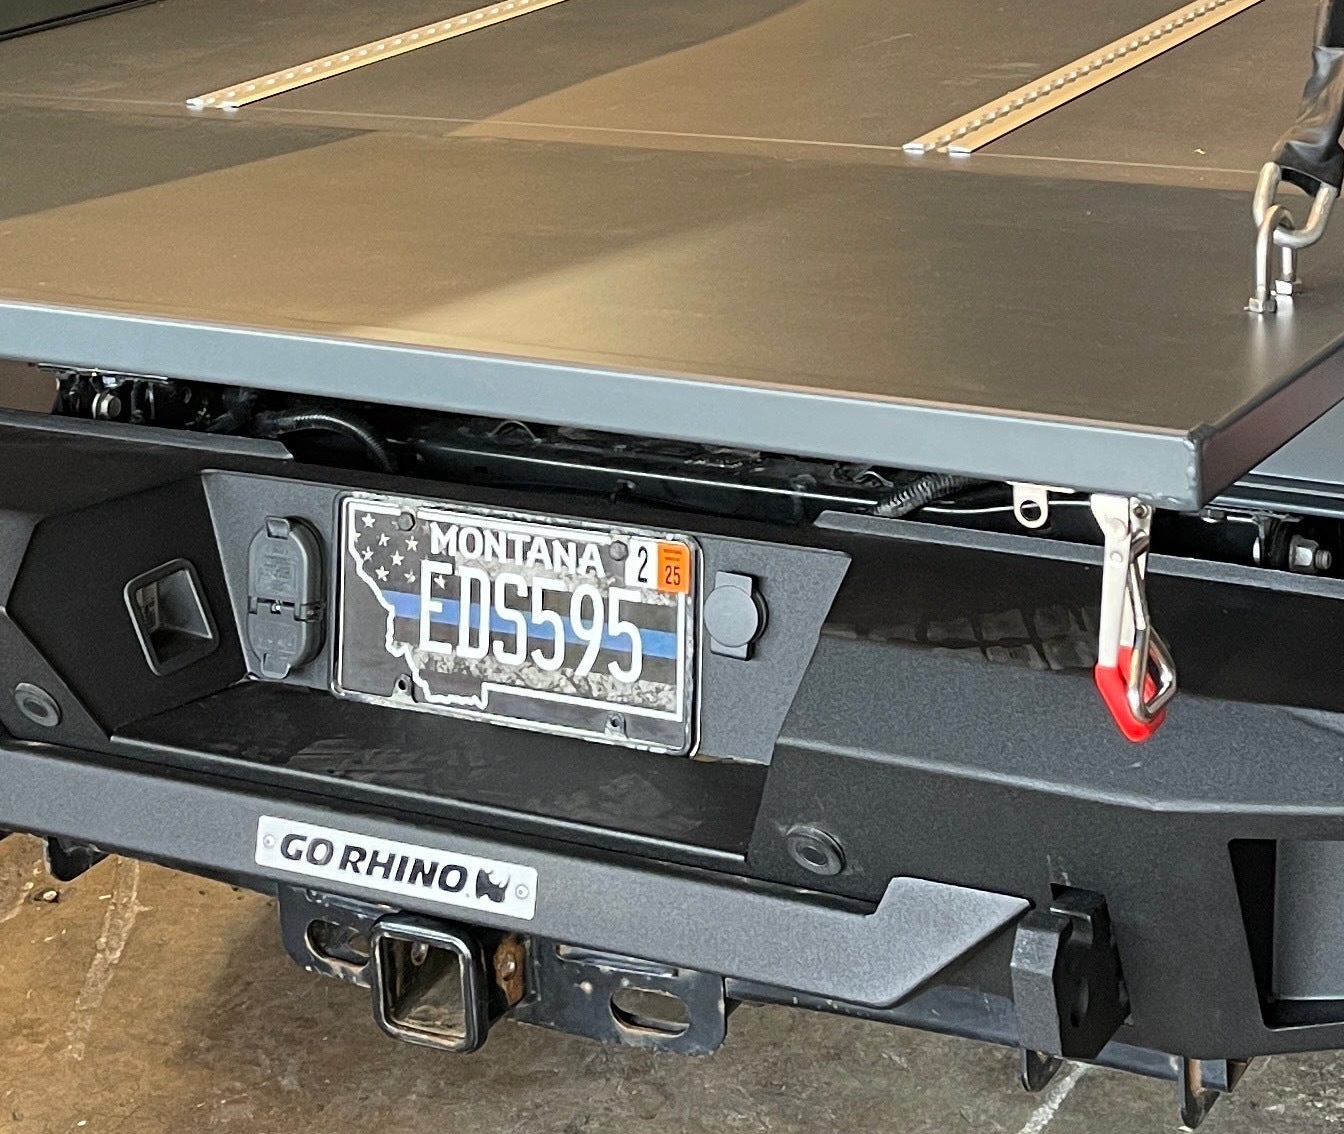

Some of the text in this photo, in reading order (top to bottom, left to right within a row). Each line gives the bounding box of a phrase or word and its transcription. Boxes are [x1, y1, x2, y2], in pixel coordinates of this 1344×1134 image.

[429, 521, 648, 583] MONTANA 2
[665, 564, 681, 586] 25
[419, 559, 644, 685] EDS595
[280, 833, 469, 893] GO RHINO
